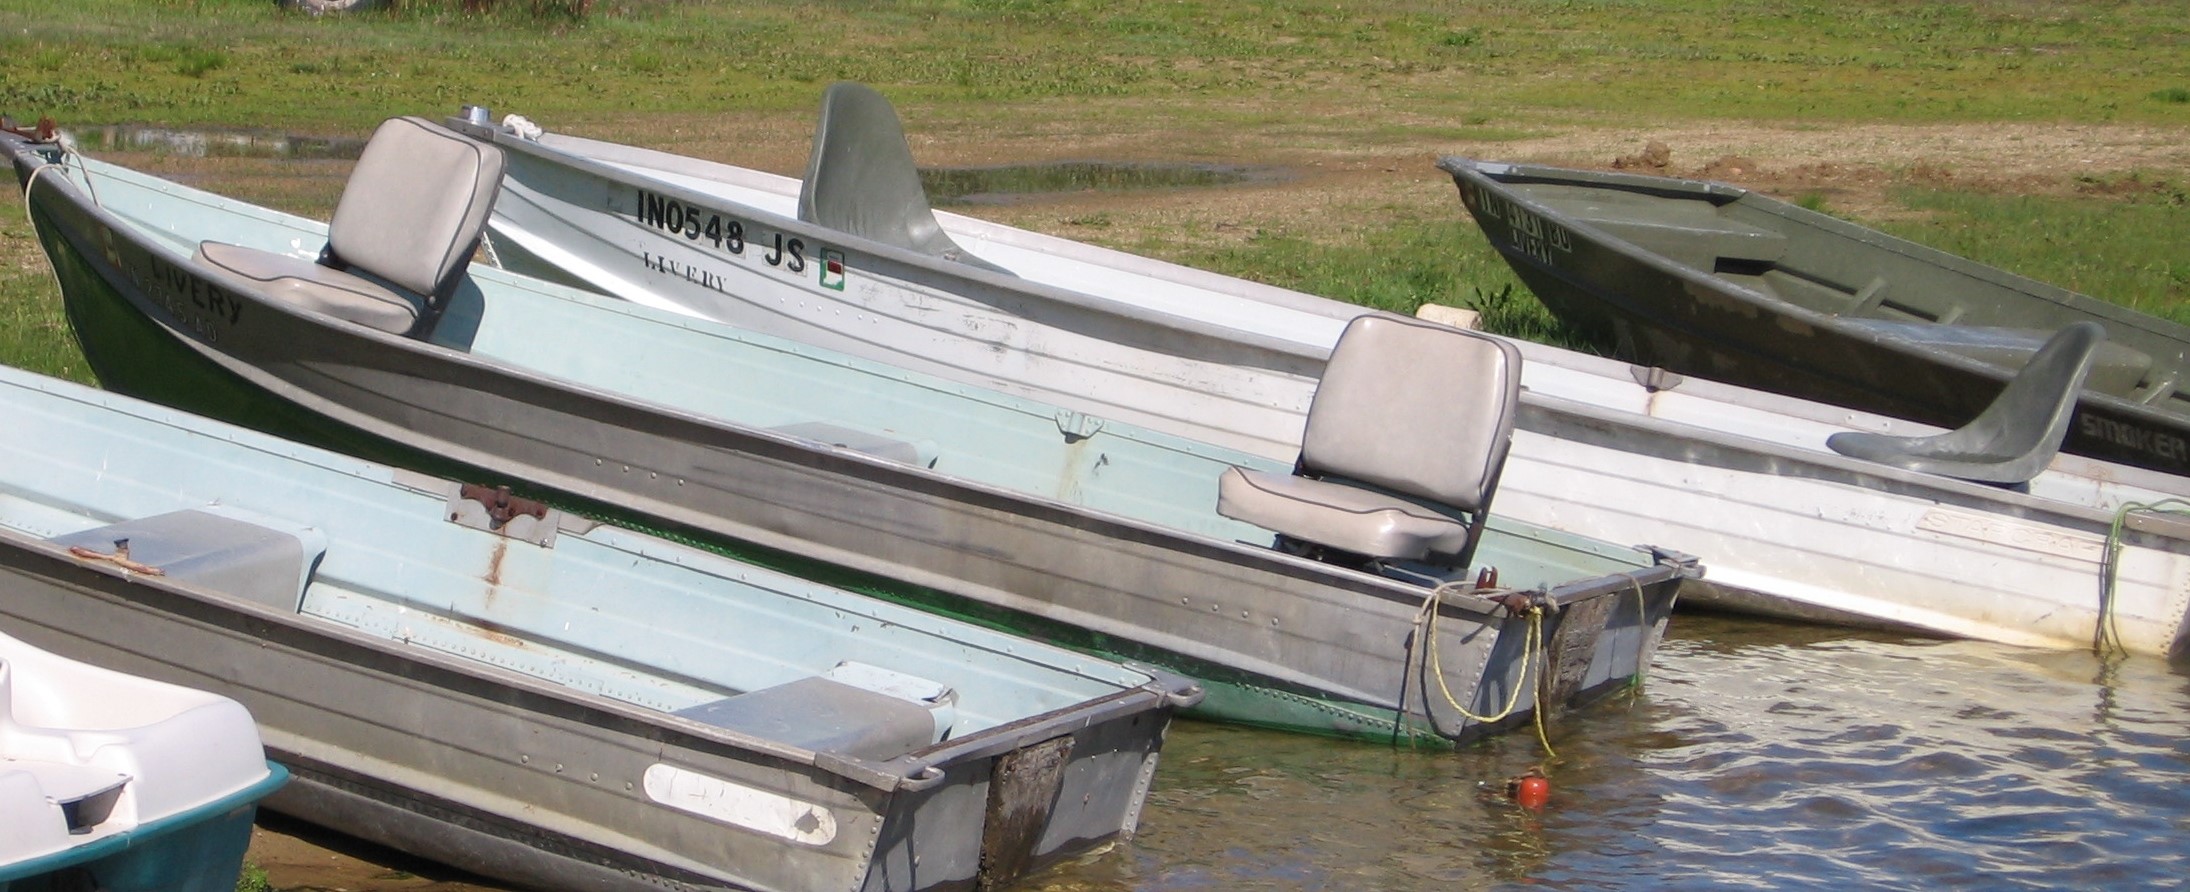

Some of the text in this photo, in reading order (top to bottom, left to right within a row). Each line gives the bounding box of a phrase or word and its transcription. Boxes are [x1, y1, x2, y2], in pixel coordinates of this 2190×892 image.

[643, 252, 728, 292] LIVERY
[765, 233, 806, 273] JS
[151, 255, 242, 325] LIVERY
